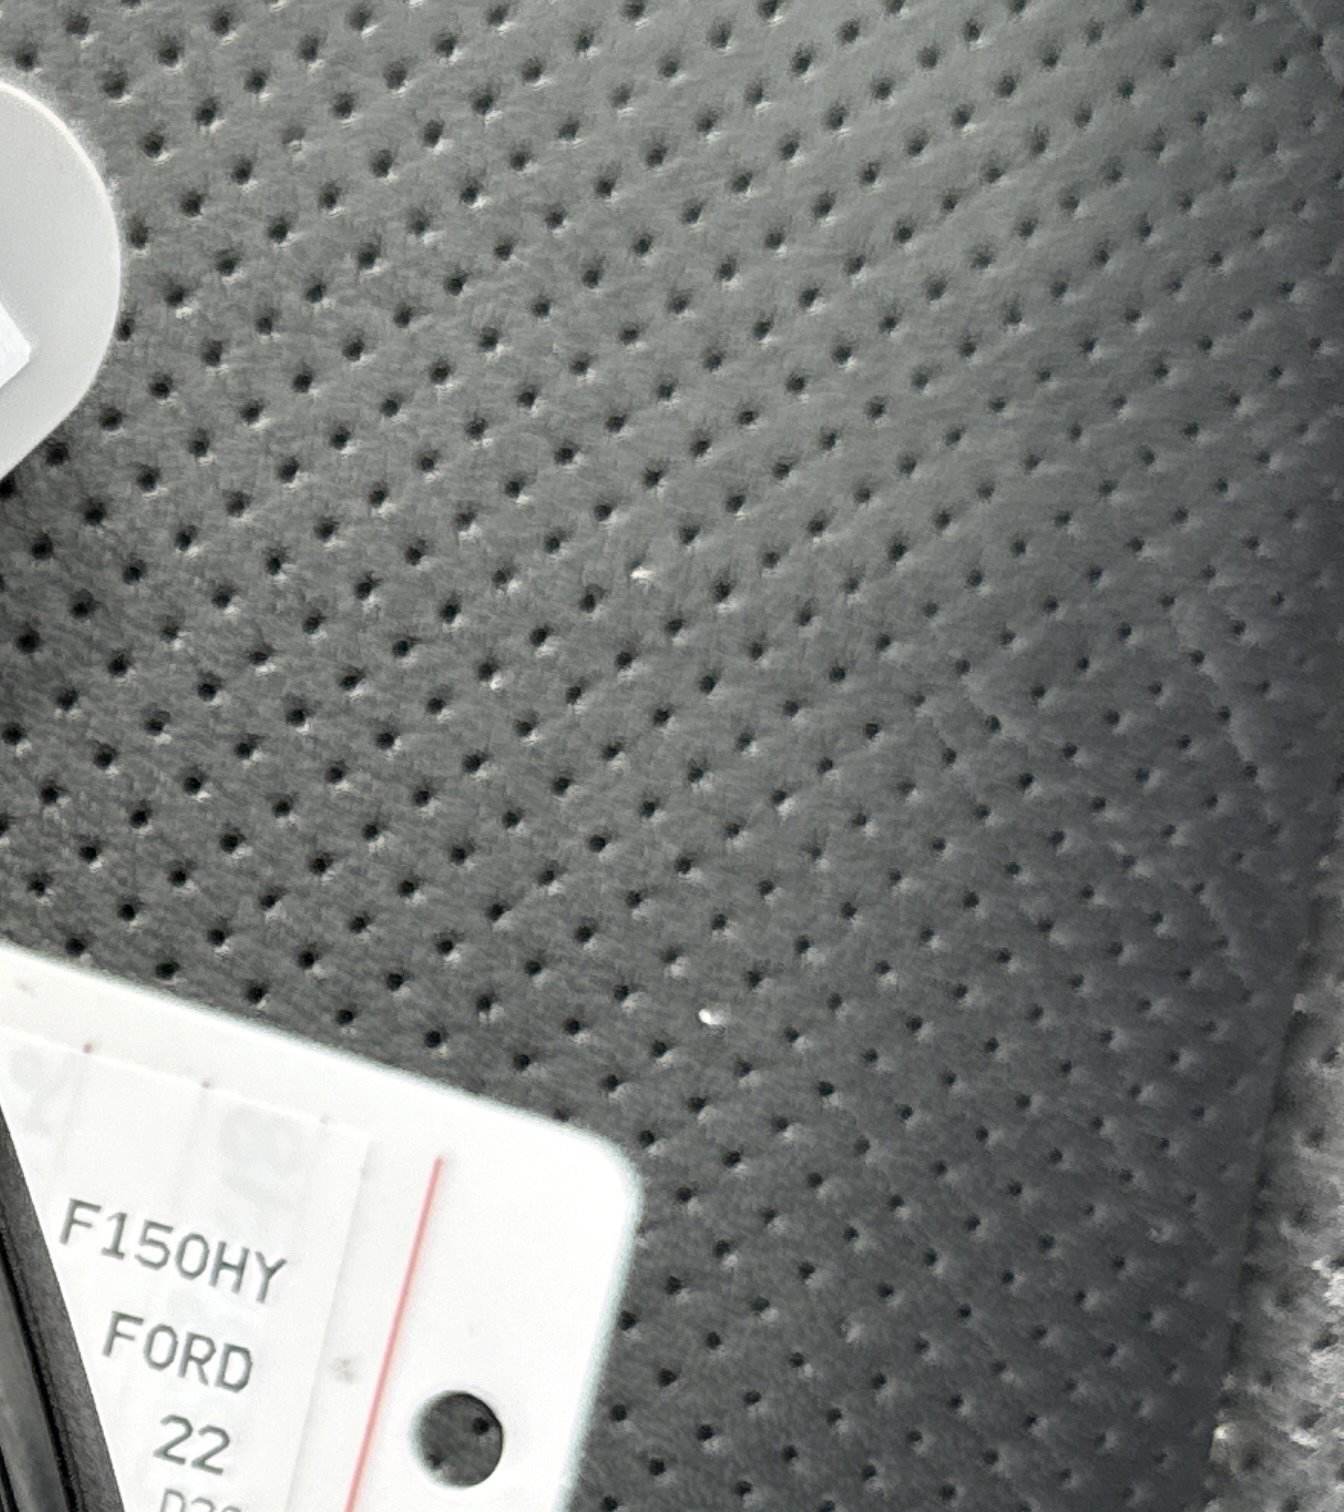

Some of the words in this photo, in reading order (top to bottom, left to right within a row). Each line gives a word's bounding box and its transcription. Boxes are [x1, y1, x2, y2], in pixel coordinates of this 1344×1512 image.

[58, 1198, 288, 1304] F150HY
[101, 1310, 254, 1394] FORD
[153, 1413, 232, 1475] 22
